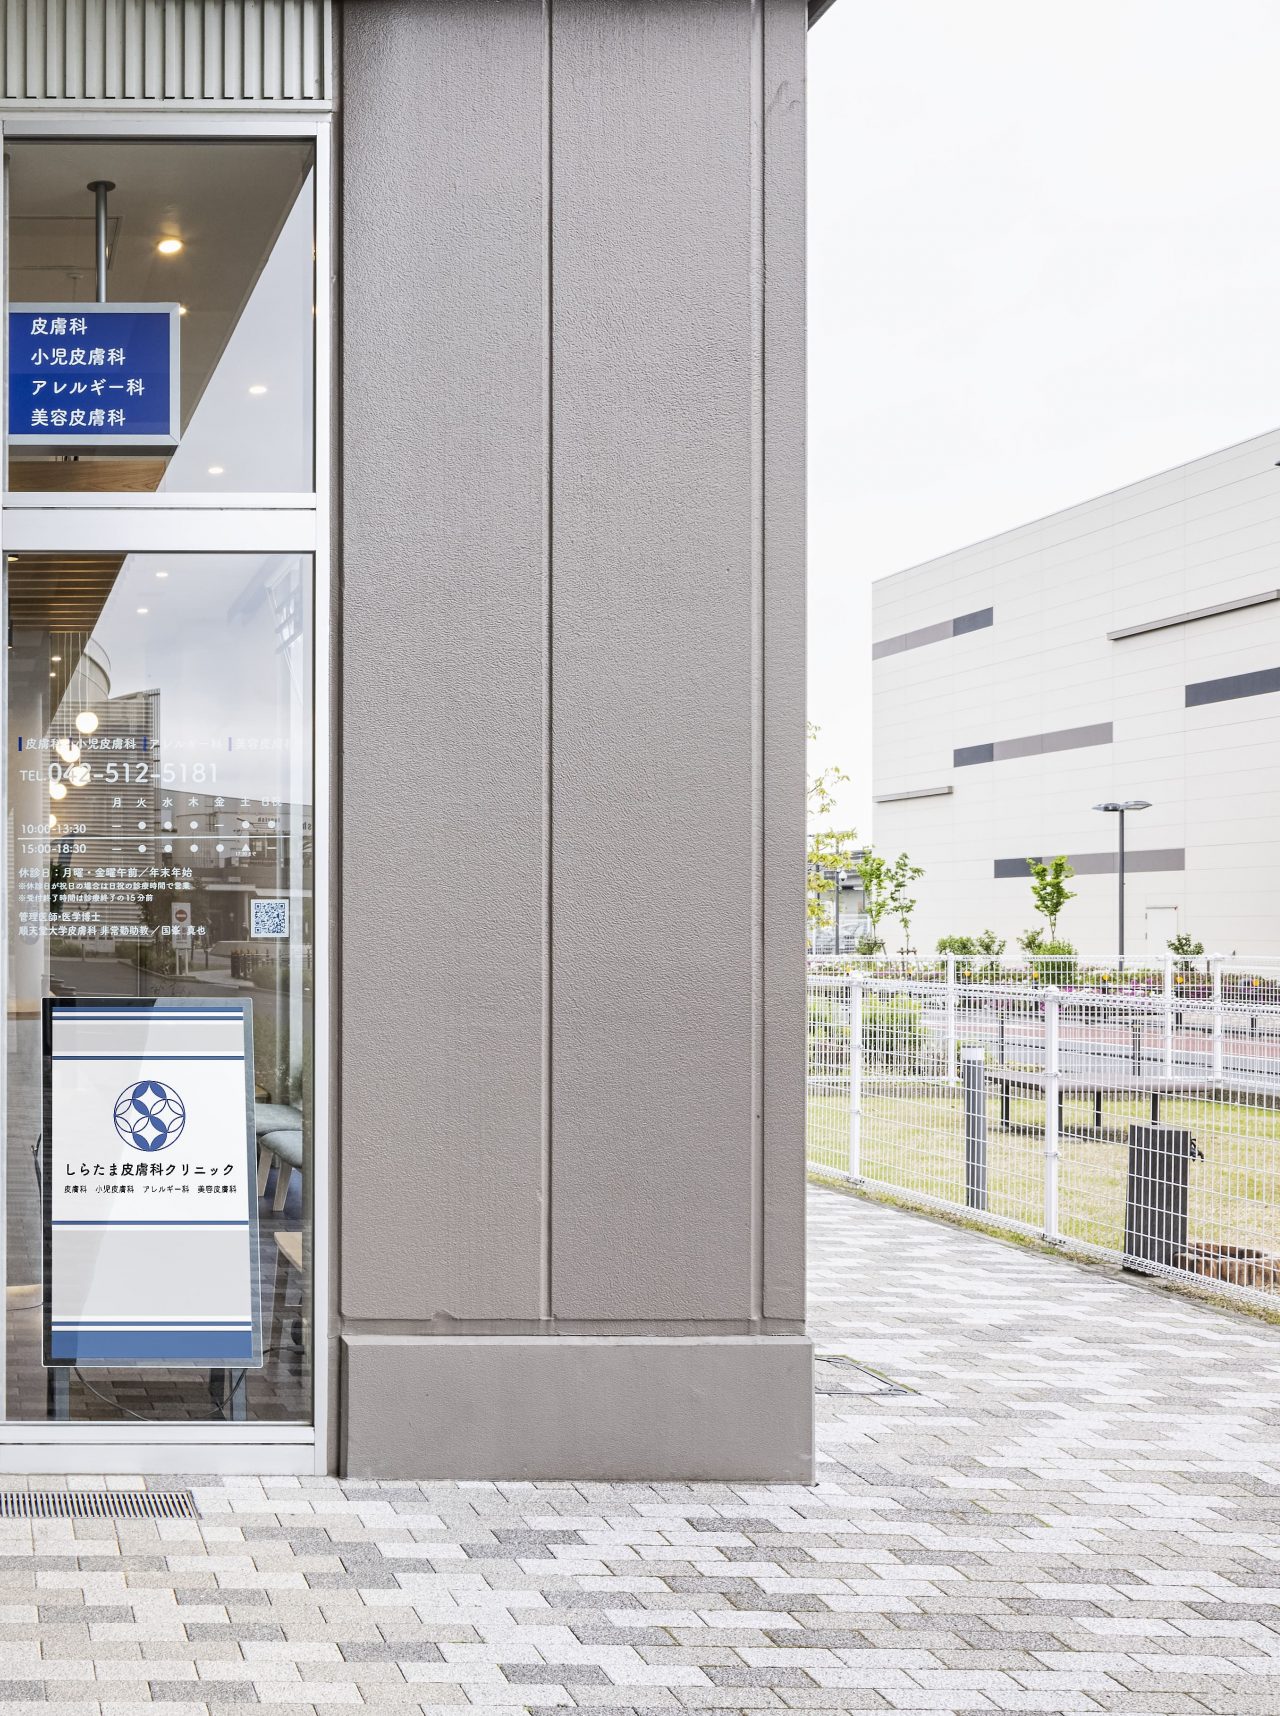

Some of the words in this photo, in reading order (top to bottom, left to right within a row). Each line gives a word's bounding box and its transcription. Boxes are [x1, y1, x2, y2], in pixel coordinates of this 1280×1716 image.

[30, 317, 89, 336] 皮膚科
[30, 348, 127, 367] 小児皮膚科
[31, 378, 145, 397] アレルギー科
[30, 408, 127, 428] 美容皮膚科
[64, 1162, 235, 1177] しらたま皮膚科クリニック
[64, 1185, 88, 1195] 皮膚科
[94, 1185, 135, 1195] 小児皮膚科
[142, 1185, 190, 1195] アレルギー科
[197, 1185, 237, 1195] 美容皮膚科
